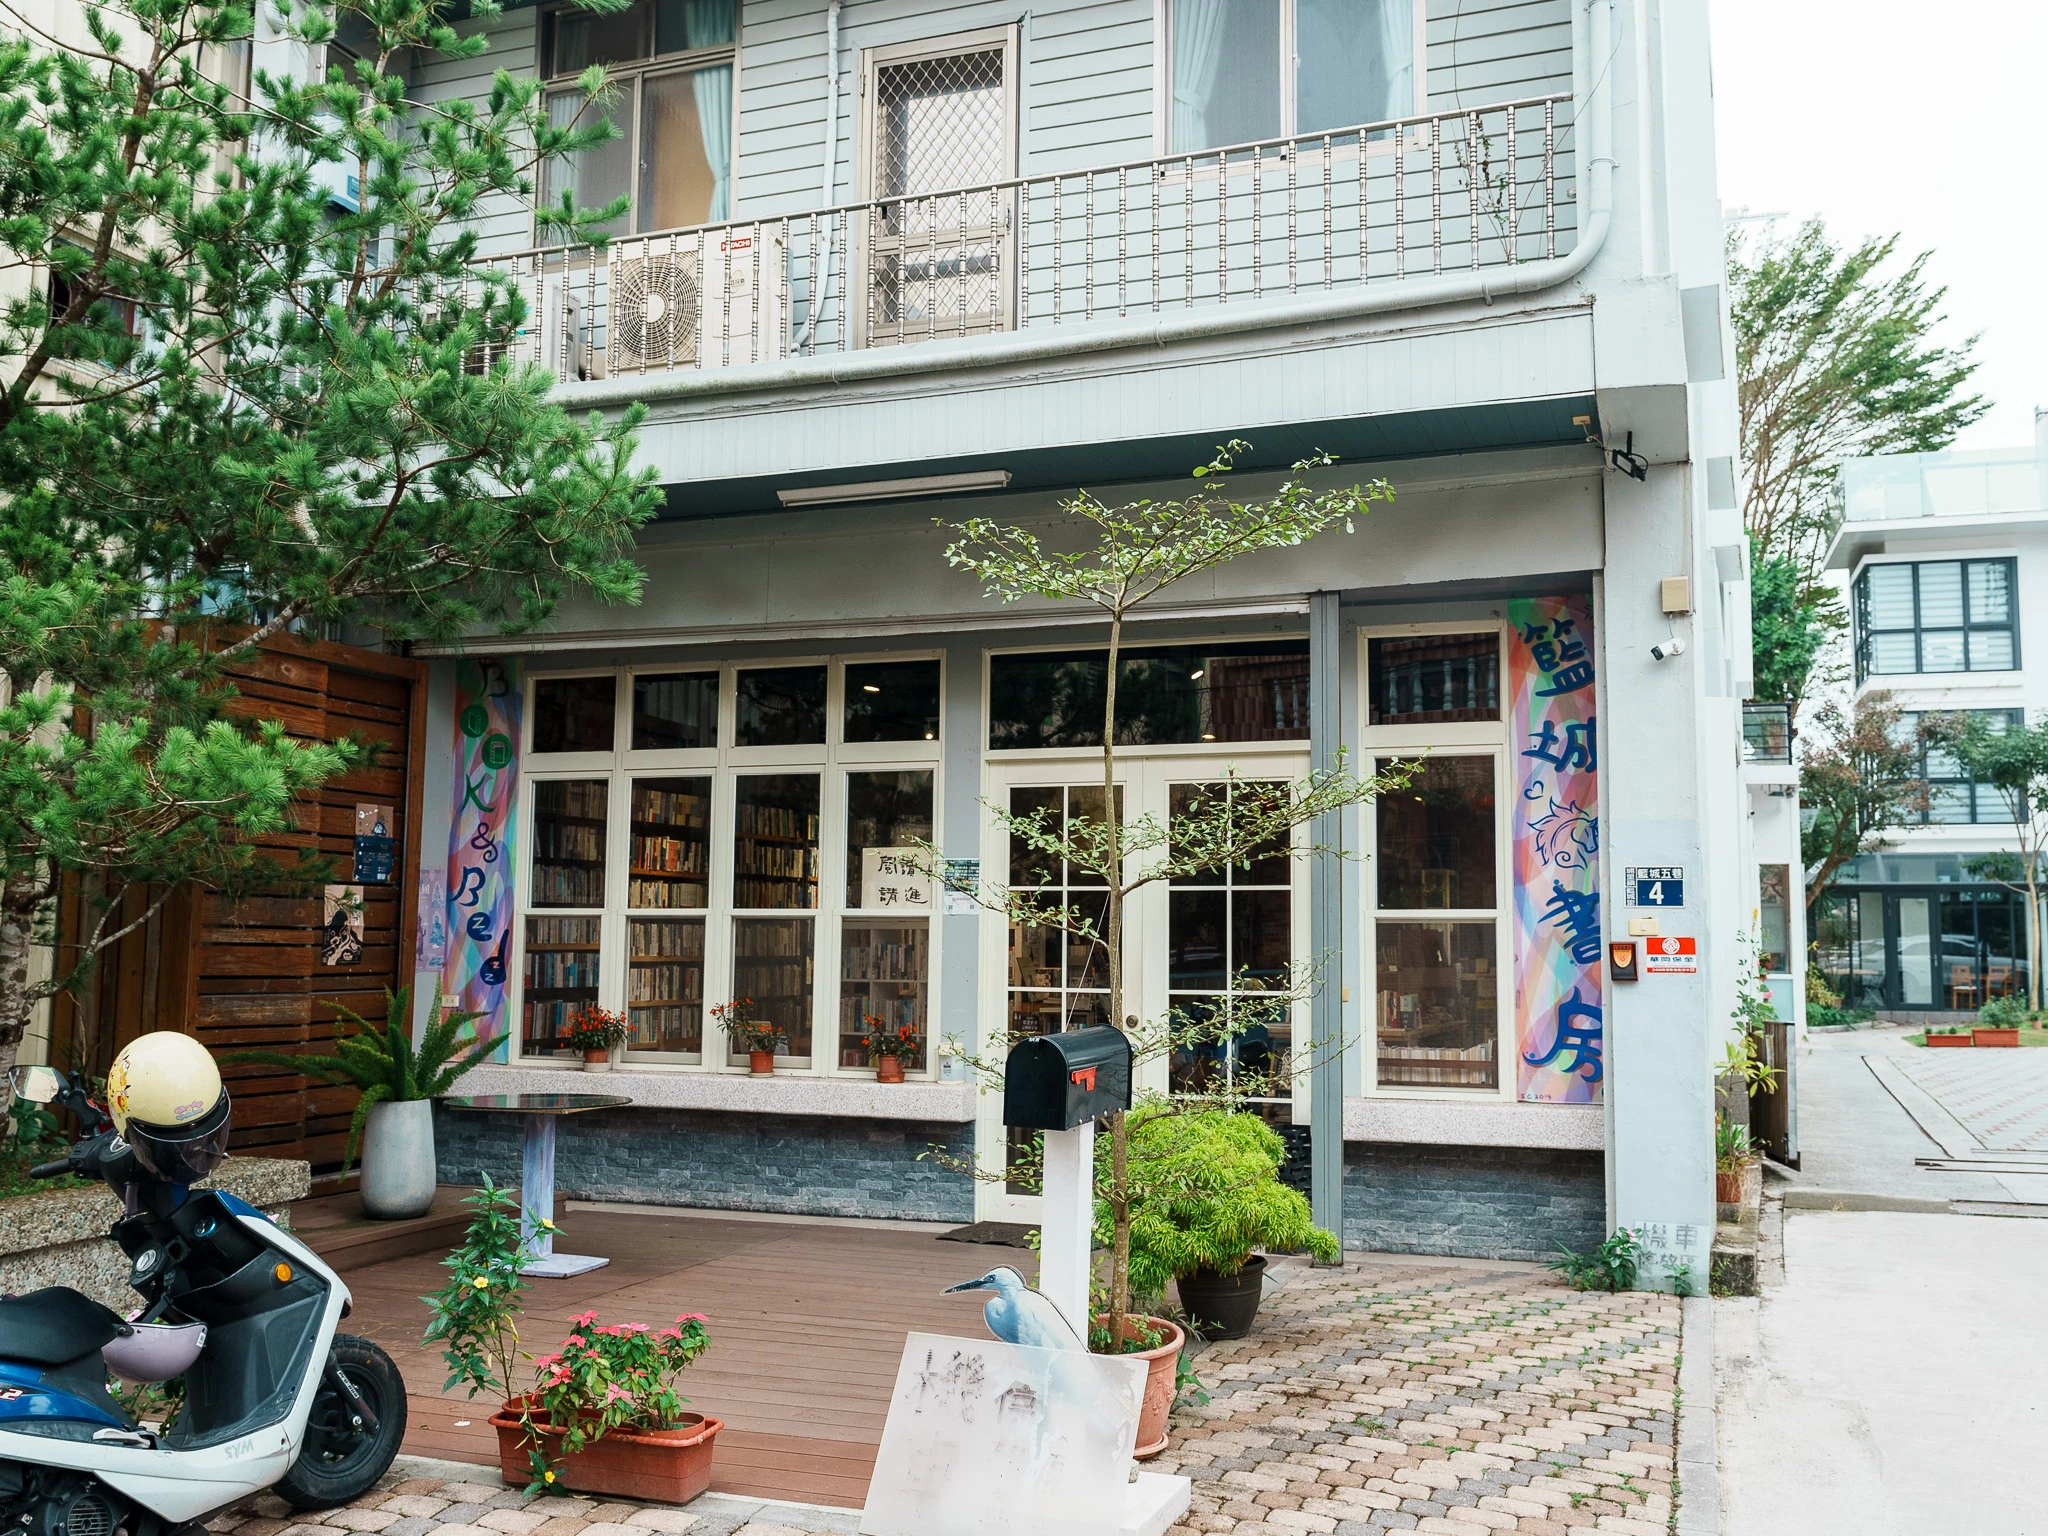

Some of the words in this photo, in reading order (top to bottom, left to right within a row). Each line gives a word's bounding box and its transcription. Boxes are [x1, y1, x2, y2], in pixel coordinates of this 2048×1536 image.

[721, 240, 750, 249] HTACHI
[878, 887, 928, 906] 請進
[1649, 881, 1665, 905] 4
[1641, 1222, 1698, 1251] 機車
[224, 1438, 255, 1460] SYM
